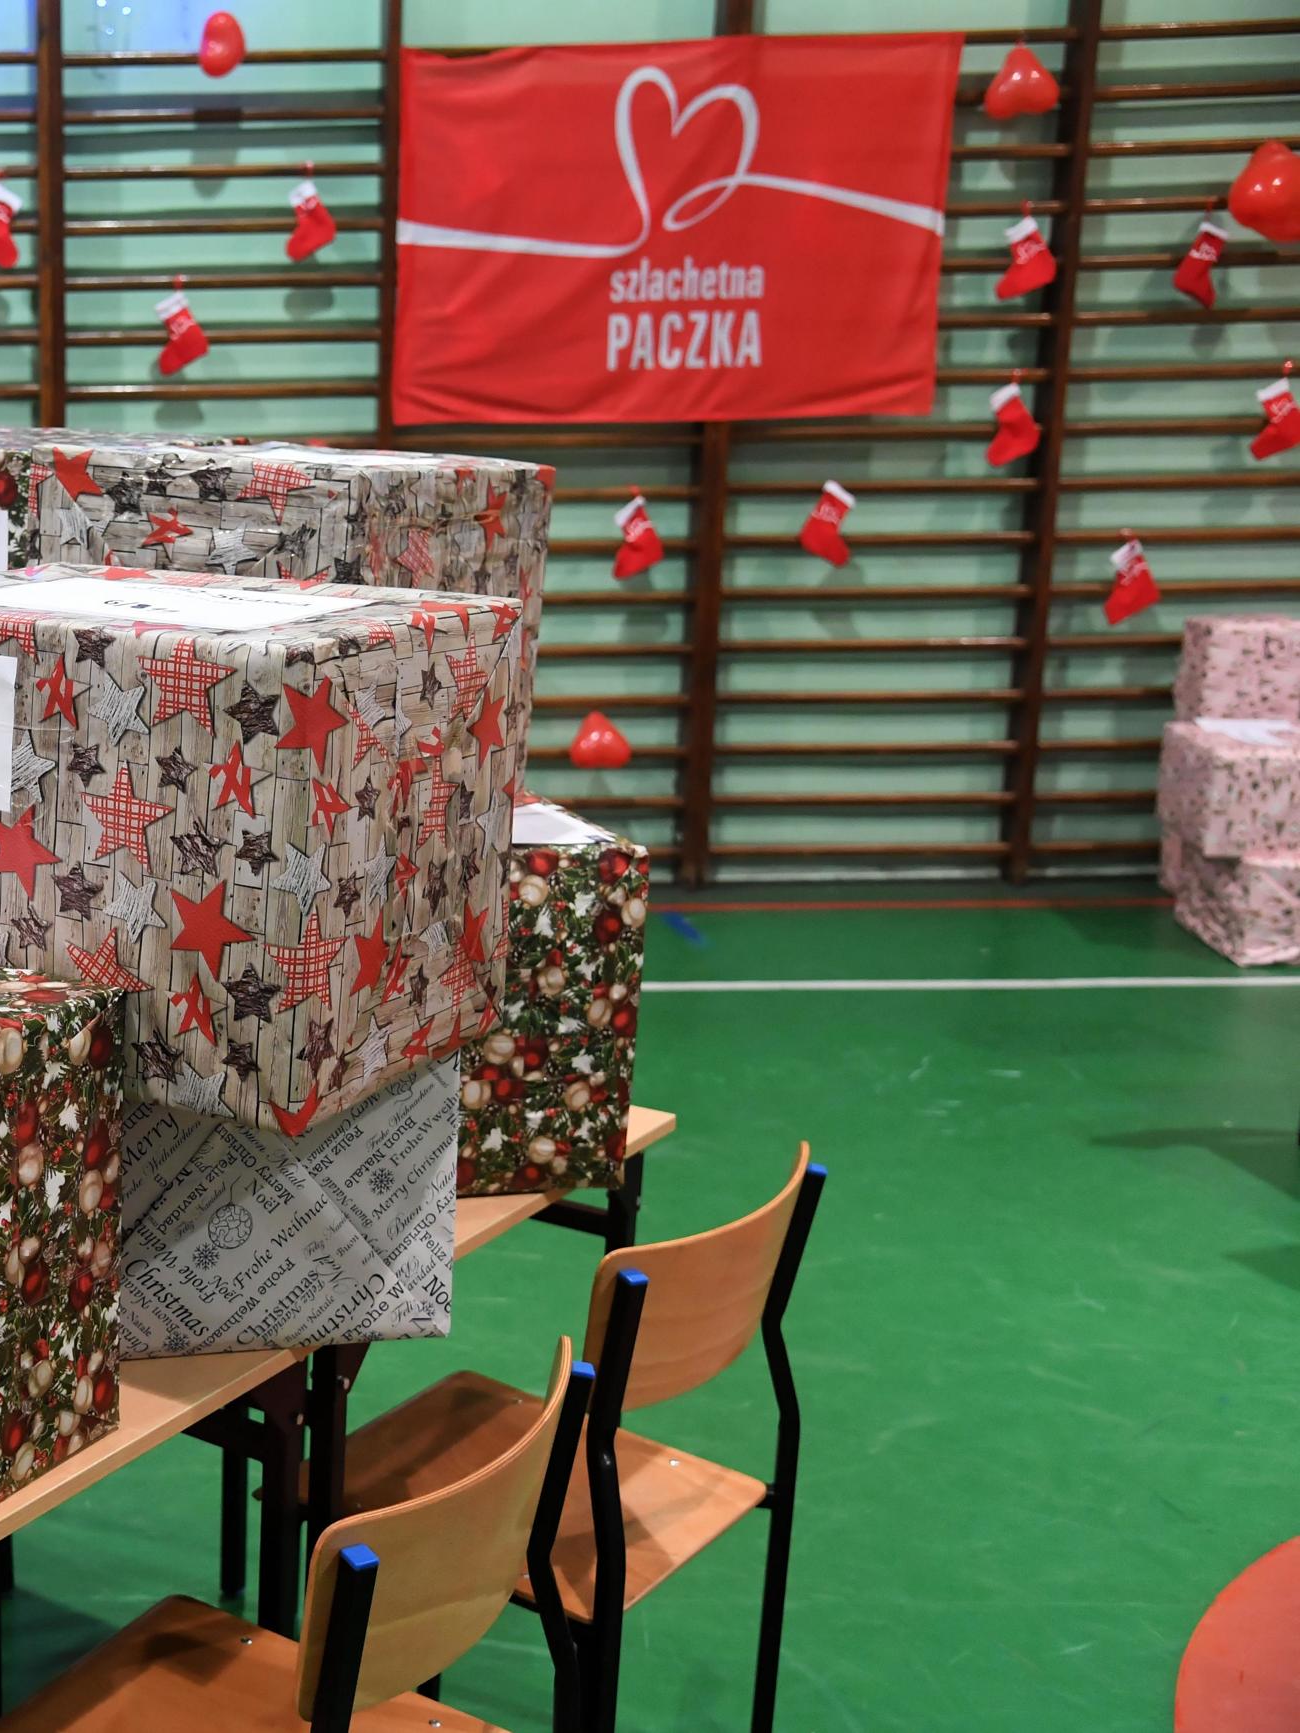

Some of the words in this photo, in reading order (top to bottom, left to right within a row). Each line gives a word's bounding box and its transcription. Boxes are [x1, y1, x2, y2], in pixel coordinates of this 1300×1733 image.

[609, 255, 765, 304] szlachetna
[606, 308, 763, 373] PACZKA
[330, 1124, 365, 1158] Feliz
[382, 1115, 418, 1150] Buon
[204, 1149, 239, 1184] Feliz
[255, 1164, 296, 1206] Merry
[343, 1147, 387, 1190] Natale
[156, 1182, 209, 1236] Navidad
[243, 1177, 281, 1215] Noël
[371, 1183, 410, 1221] Merry
[419, 1230, 447, 1261] Feliz
[178, 1265, 217, 1305] Frohe
[207, 1274, 244, 1304] Noël
[232, 1249, 274, 1292] Frohe
[257, 1256, 297, 1296] Frohe
[124, 1258, 210, 1338] Christmas
[235, 1269, 320, 1346] Christmas
[341, 1300, 391, 1342] Frohe
